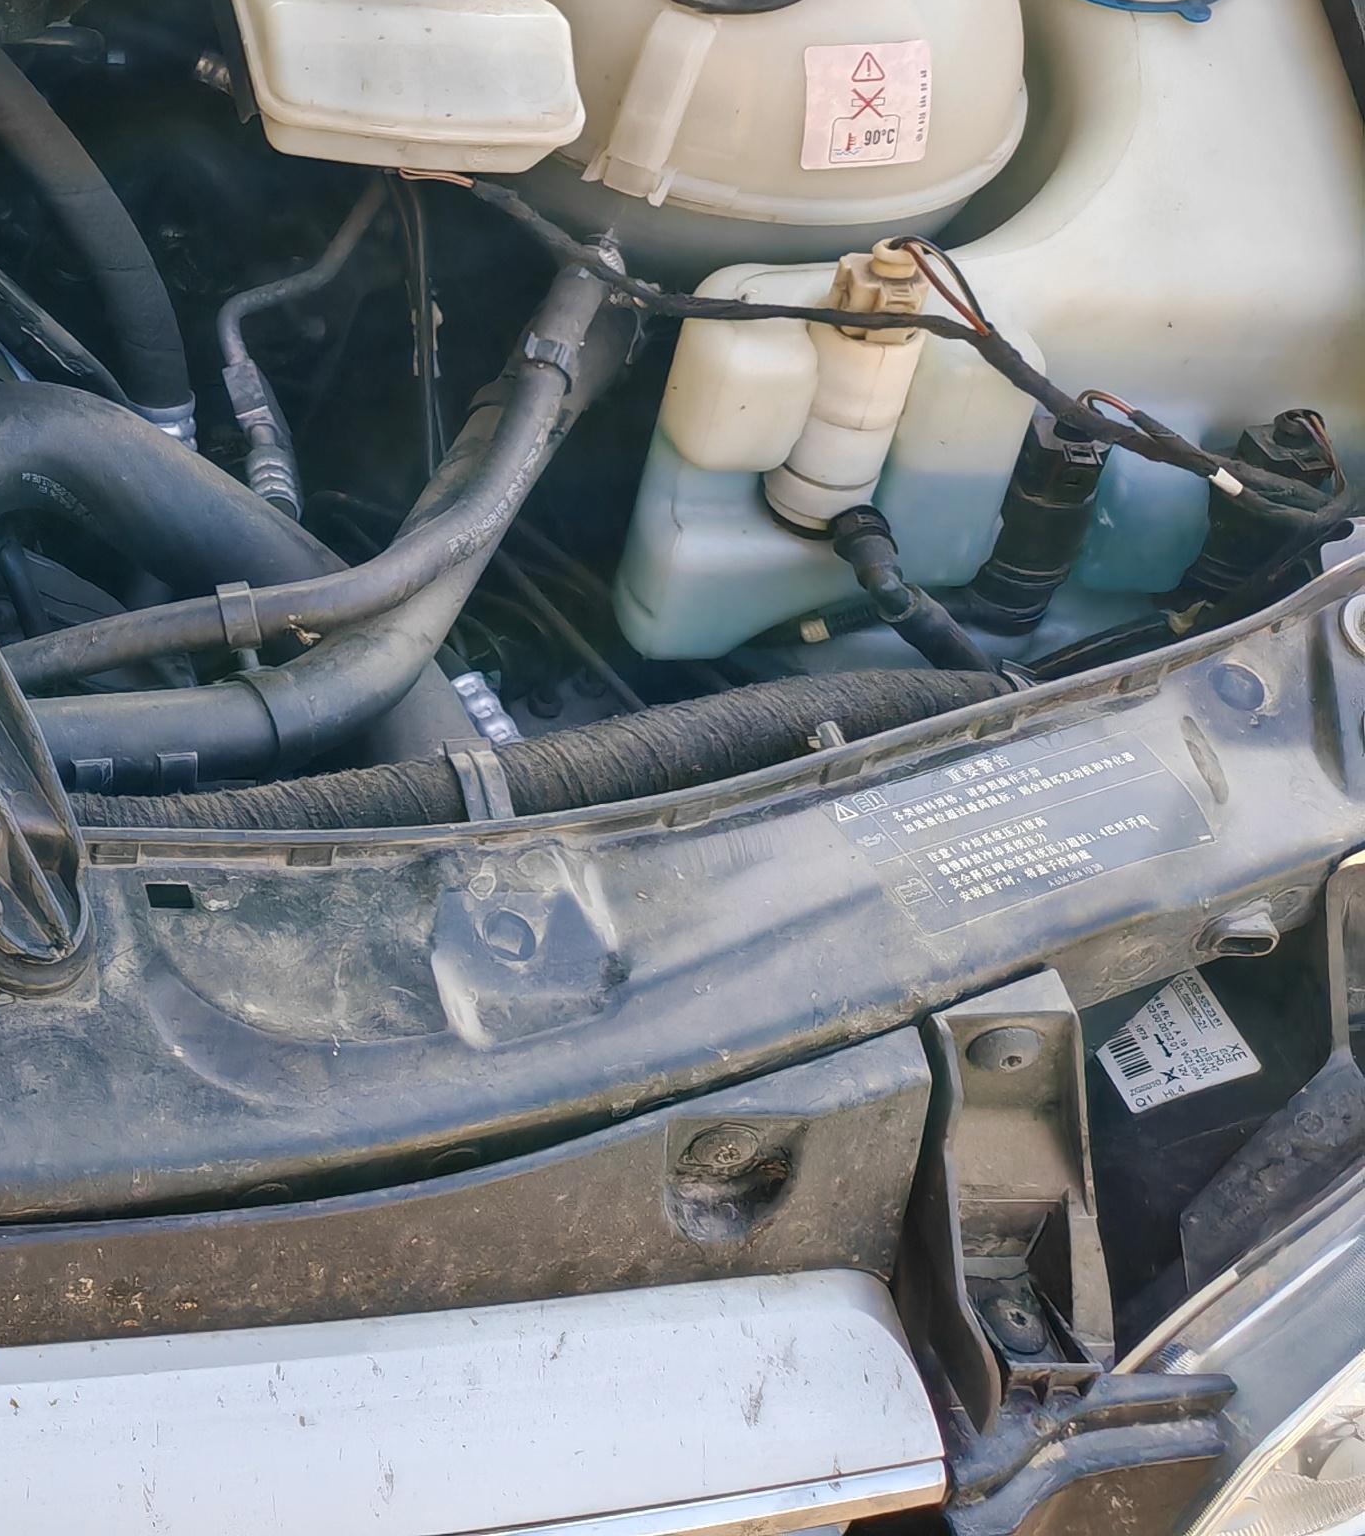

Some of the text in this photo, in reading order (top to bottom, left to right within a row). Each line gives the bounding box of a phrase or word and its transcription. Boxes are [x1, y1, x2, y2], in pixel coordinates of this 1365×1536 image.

[863, 128, 895, 146] 90°C
[945, 754, 1011, 785] 重要警告
[1226, 1042, 1247, 1062] XE
[1162, 1085, 1186, 1099] HL4
[1135, 1096, 1154, 1108] Q1
